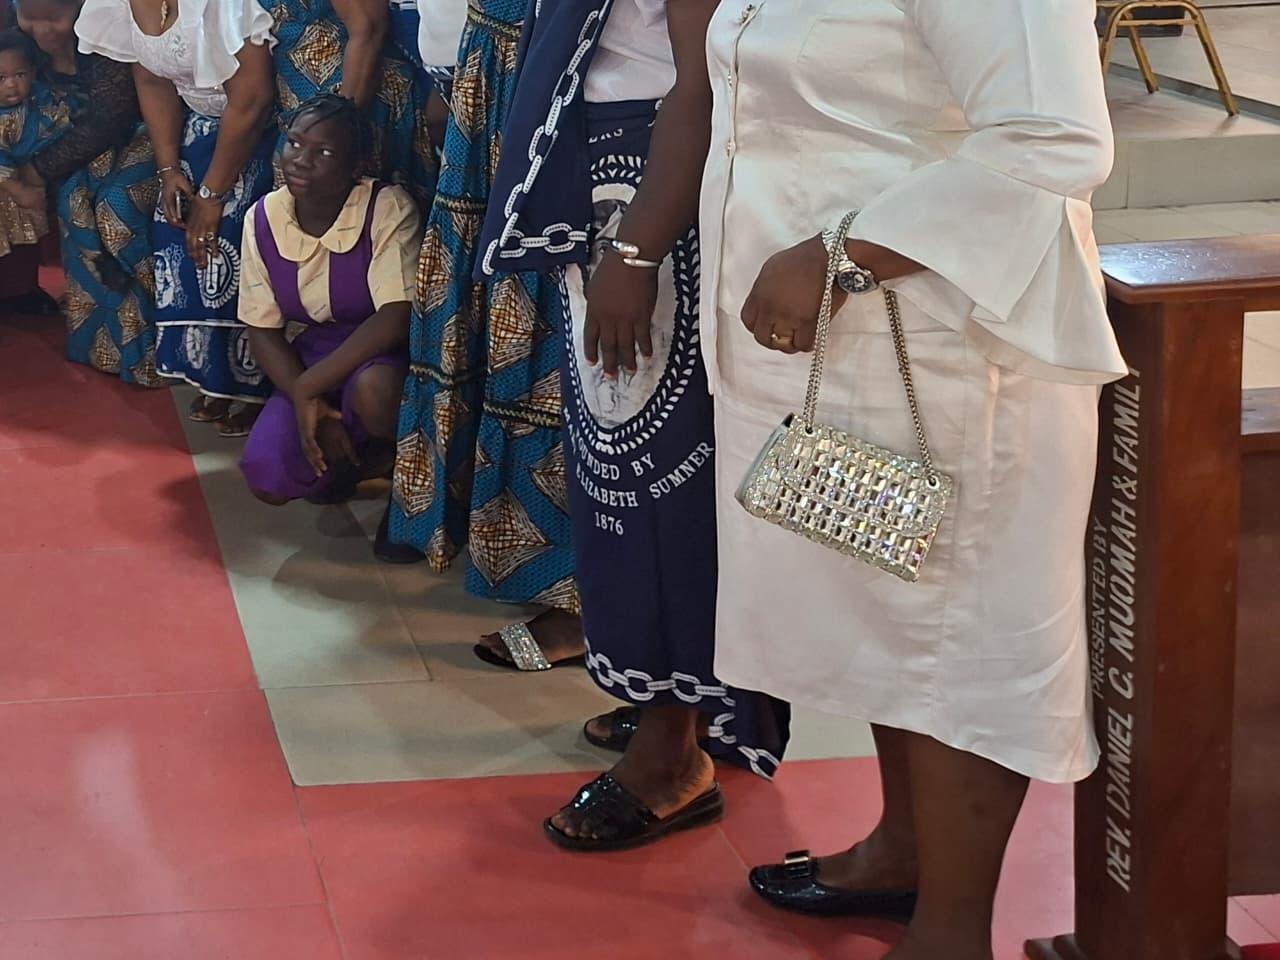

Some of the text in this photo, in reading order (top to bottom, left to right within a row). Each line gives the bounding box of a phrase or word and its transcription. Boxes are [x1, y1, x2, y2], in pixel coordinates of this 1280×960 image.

[630, 452, 656, 477] BY
[648, 441, 715, 499] SUMNER
[1111, 474, 1138, 501] &
[594, 511, 624, 536] 1876
[1093, 515, 1108, 555] BY
[1107, 665, 1135, 701] C.
[1106, 706, 1134, 820] DANIEL
[1105, 815, 1132, 893] REV.
